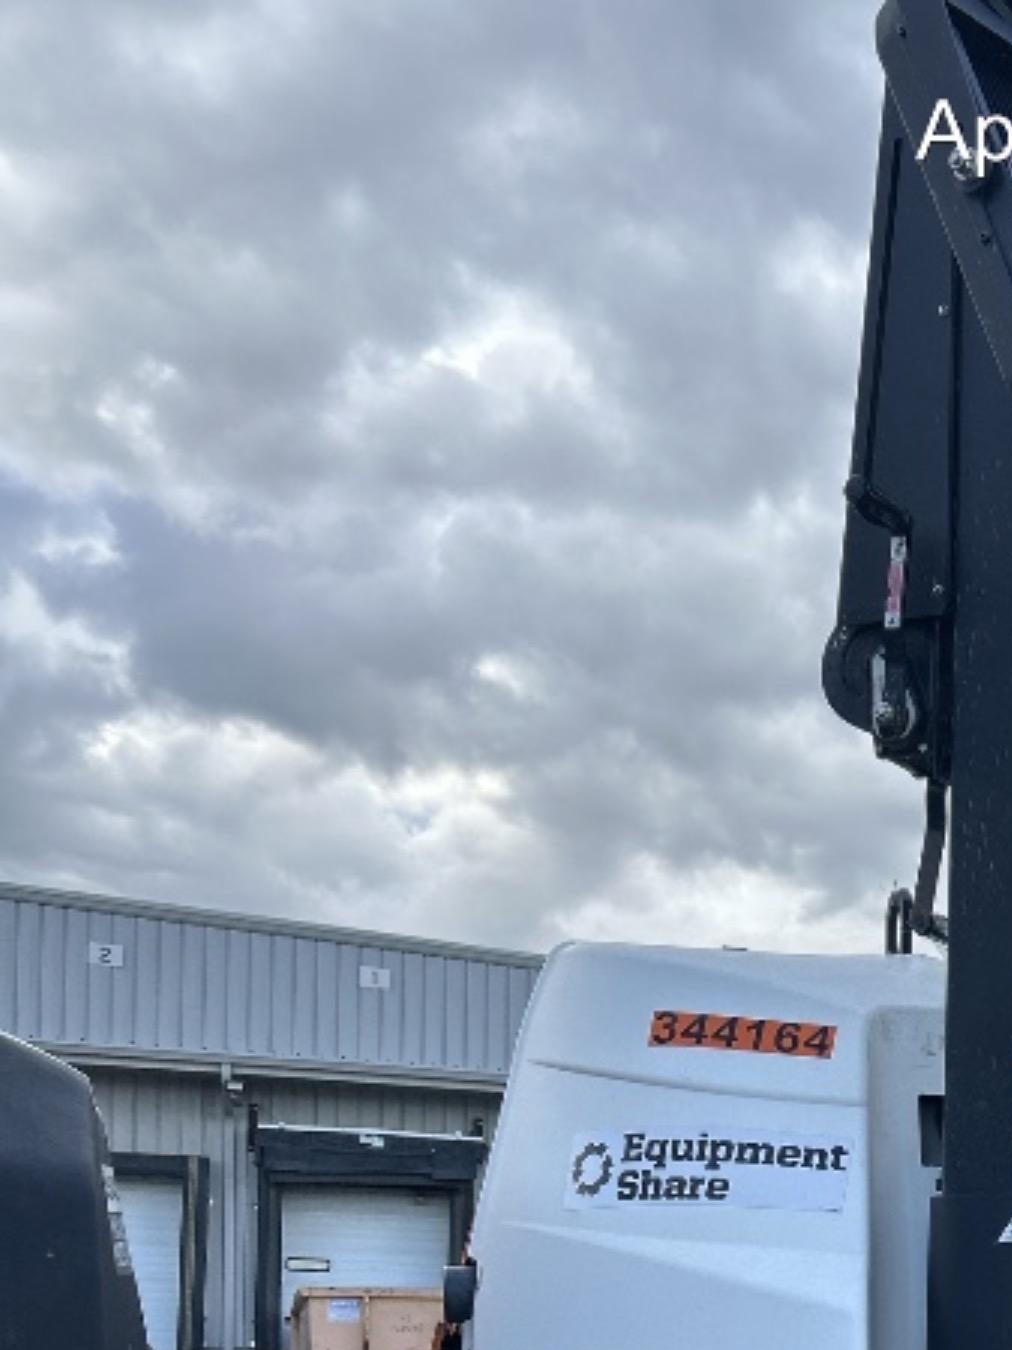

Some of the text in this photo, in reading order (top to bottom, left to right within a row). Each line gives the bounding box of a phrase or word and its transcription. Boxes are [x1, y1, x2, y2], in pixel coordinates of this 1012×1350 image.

[98, 947, 113, 964] 2
[652, 1011, 831, 1056] 344164
[620, 1133, 850, 1171] Equipment
[616, 1169, 730, 1202] Share
